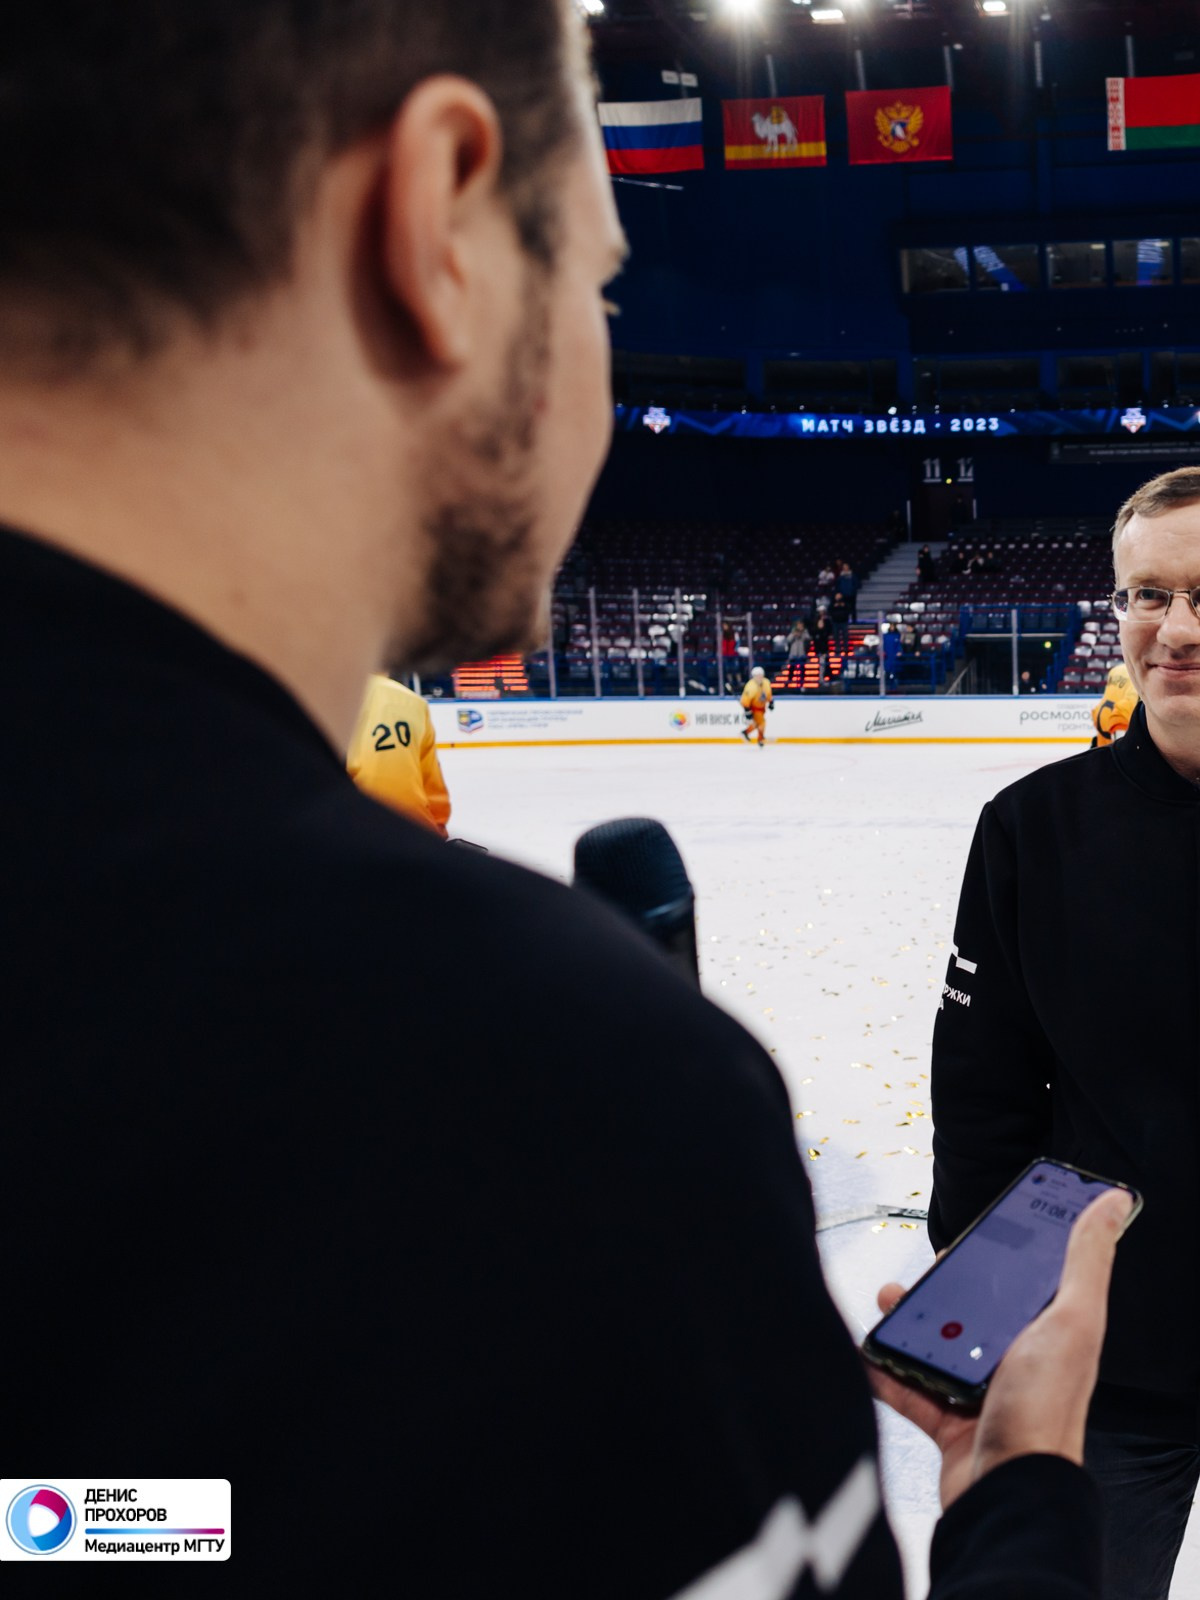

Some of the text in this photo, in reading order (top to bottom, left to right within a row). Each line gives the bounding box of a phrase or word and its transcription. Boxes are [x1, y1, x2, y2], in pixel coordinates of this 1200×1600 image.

[801, 417, 999, 434] МАТЧ ЗВЁЗД 2023
[1020, 711, 1092, 725] росмоло
[372, 721, 411, 751] 20
[943, 984, 971, 1007] РЖКИ
